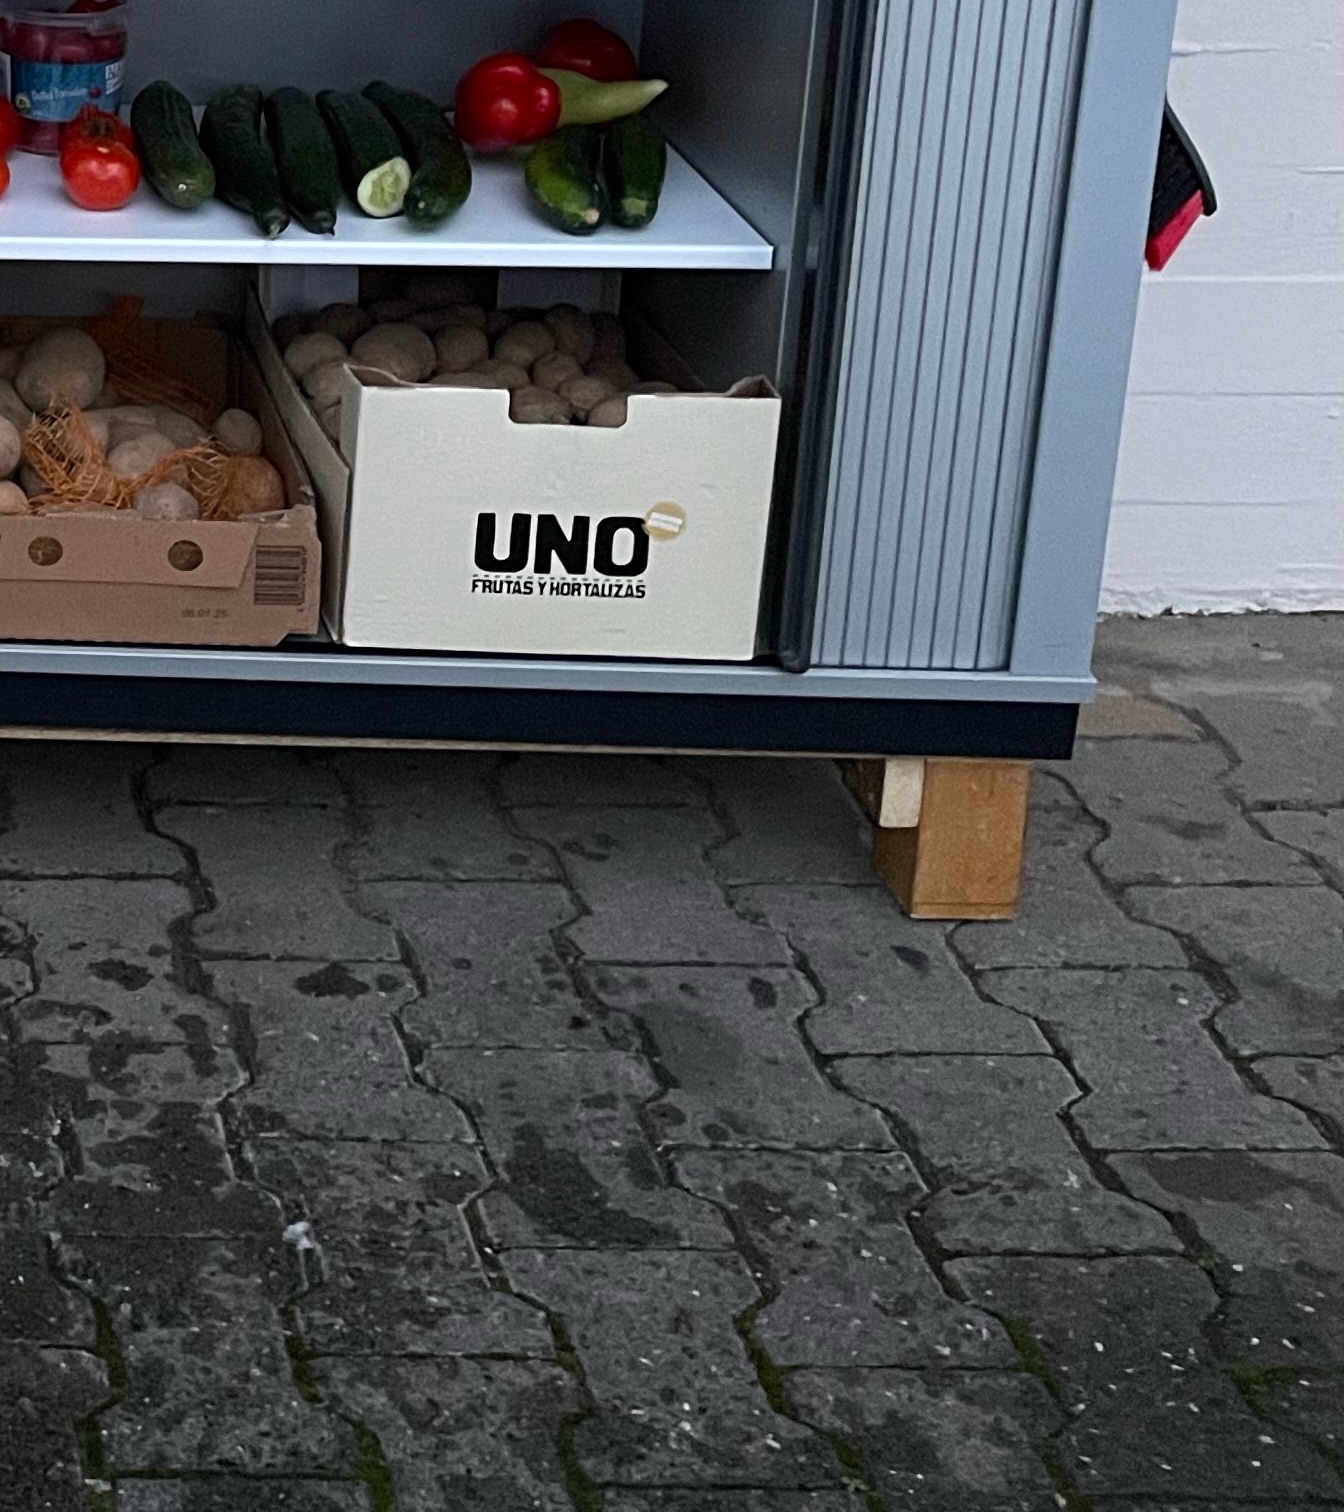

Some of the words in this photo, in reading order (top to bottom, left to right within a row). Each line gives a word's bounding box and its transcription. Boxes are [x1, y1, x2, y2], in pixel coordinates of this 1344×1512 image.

[474, 512, 650, 577] UNO
[470, 578, 535, 596] FRUTAS
[538, 580, 548, 595] Y
